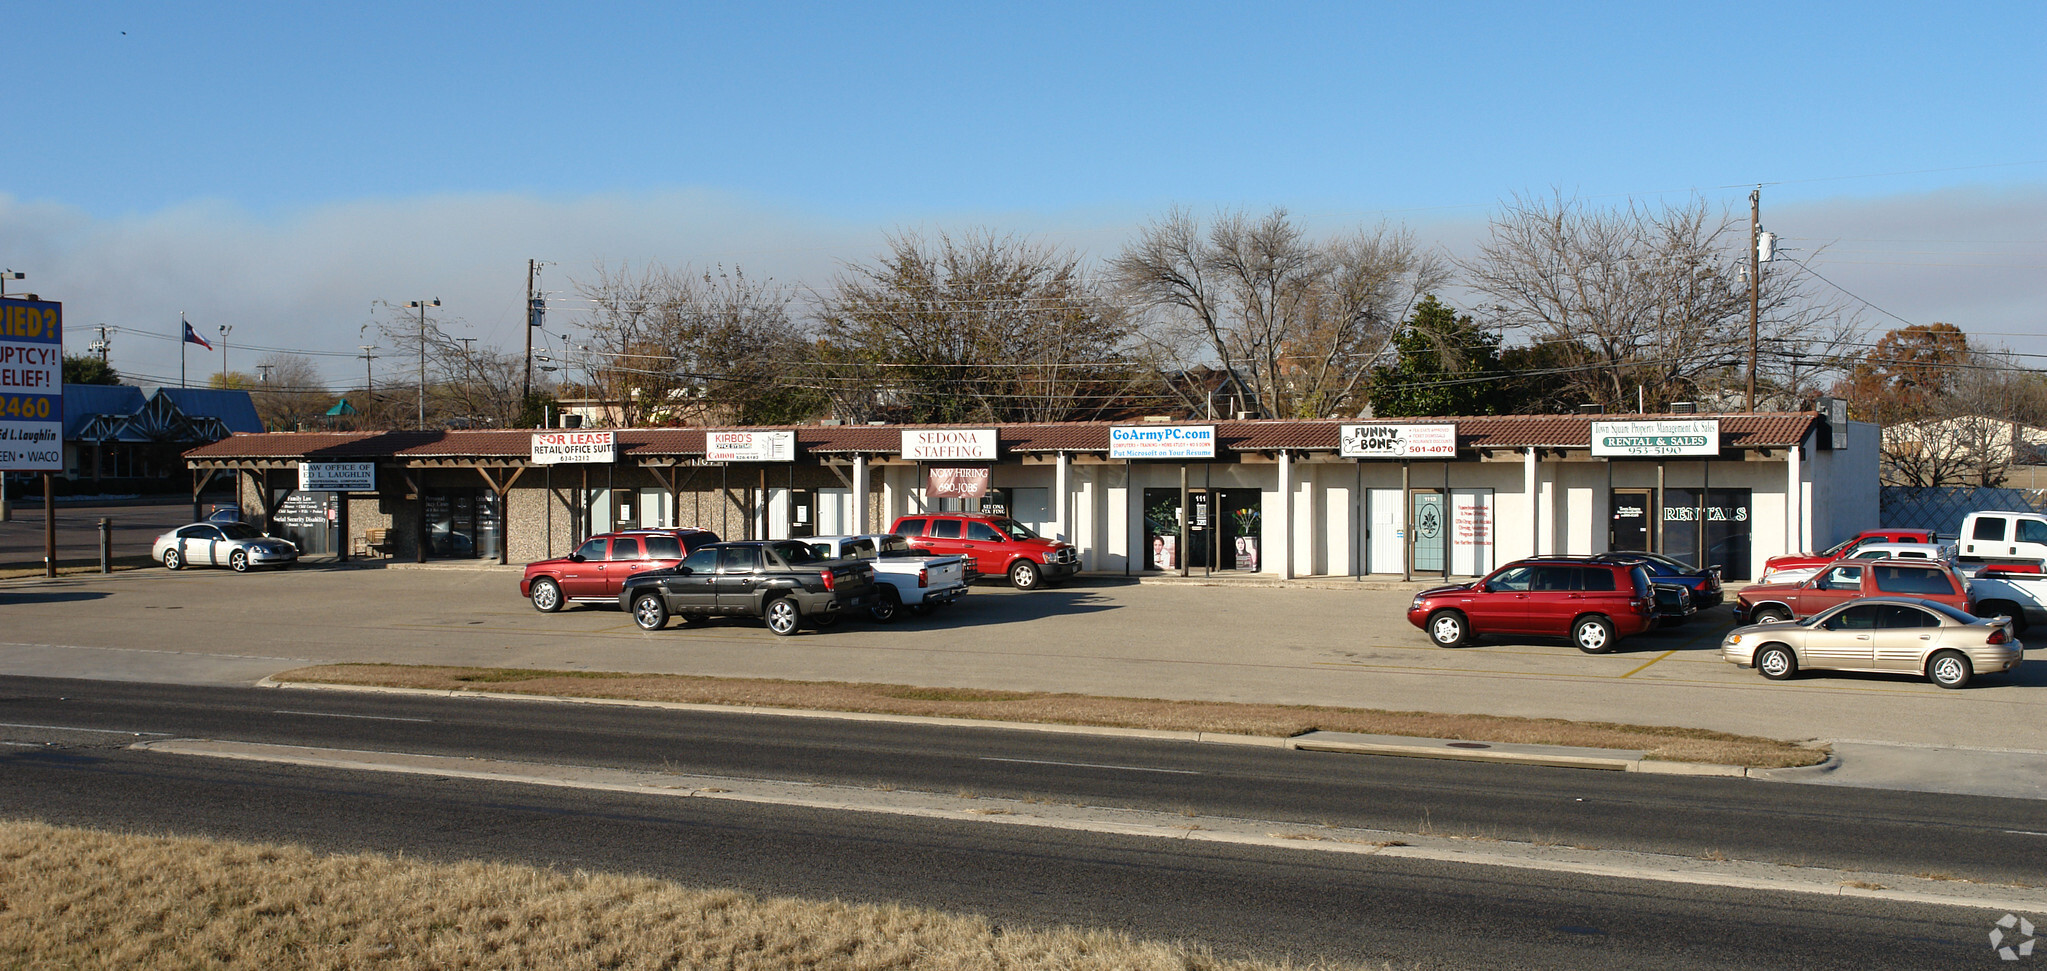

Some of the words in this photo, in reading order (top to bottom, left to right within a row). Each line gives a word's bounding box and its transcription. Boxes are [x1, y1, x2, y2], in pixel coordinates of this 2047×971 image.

[0, 369, 50, 387] ELIEF!
[1355, 426, 1398, 438] FUNNY
[1595, 423, 1609, 433] Town
[1611, 423, 1629, 436] Square
[1631, 422, 1654, 435] Property
[1656, 422, 1691, 434] Management
[1693, 422, 1699, 433] &
[1701, 421, 1715, 433] Sales
[18, 430, 56, 444] Laughlin
[538, 434, 566, 445] FOR
[570, 433, 610, 444] LEASE
[715, 433, 752, 443] KIRBO'S
[918, 432, 977, 444] SEDONA
[1113, 429, 1210, 441] GoArmyPC.com
[1360, 438, 1393, 450] BONE
[1608, 437, 1652, 446] RENTAL
[1656, 437, 1666, 446] &
[1670, 437, 1704, 446] SALES
[593, 444, 616, 453] SUITE
[914, 445, 982, 458] STAFFING
[1628, 446, 1682, 454] 953-5190
[27, 451, 59, 463] WACO
[930, 468, 953, 478] NOW
[955, 468, 988, 478] HIRING
[938, 482, 978, 494] 690-JOBS
[1664, 507, 1747, 521] RENTALS
